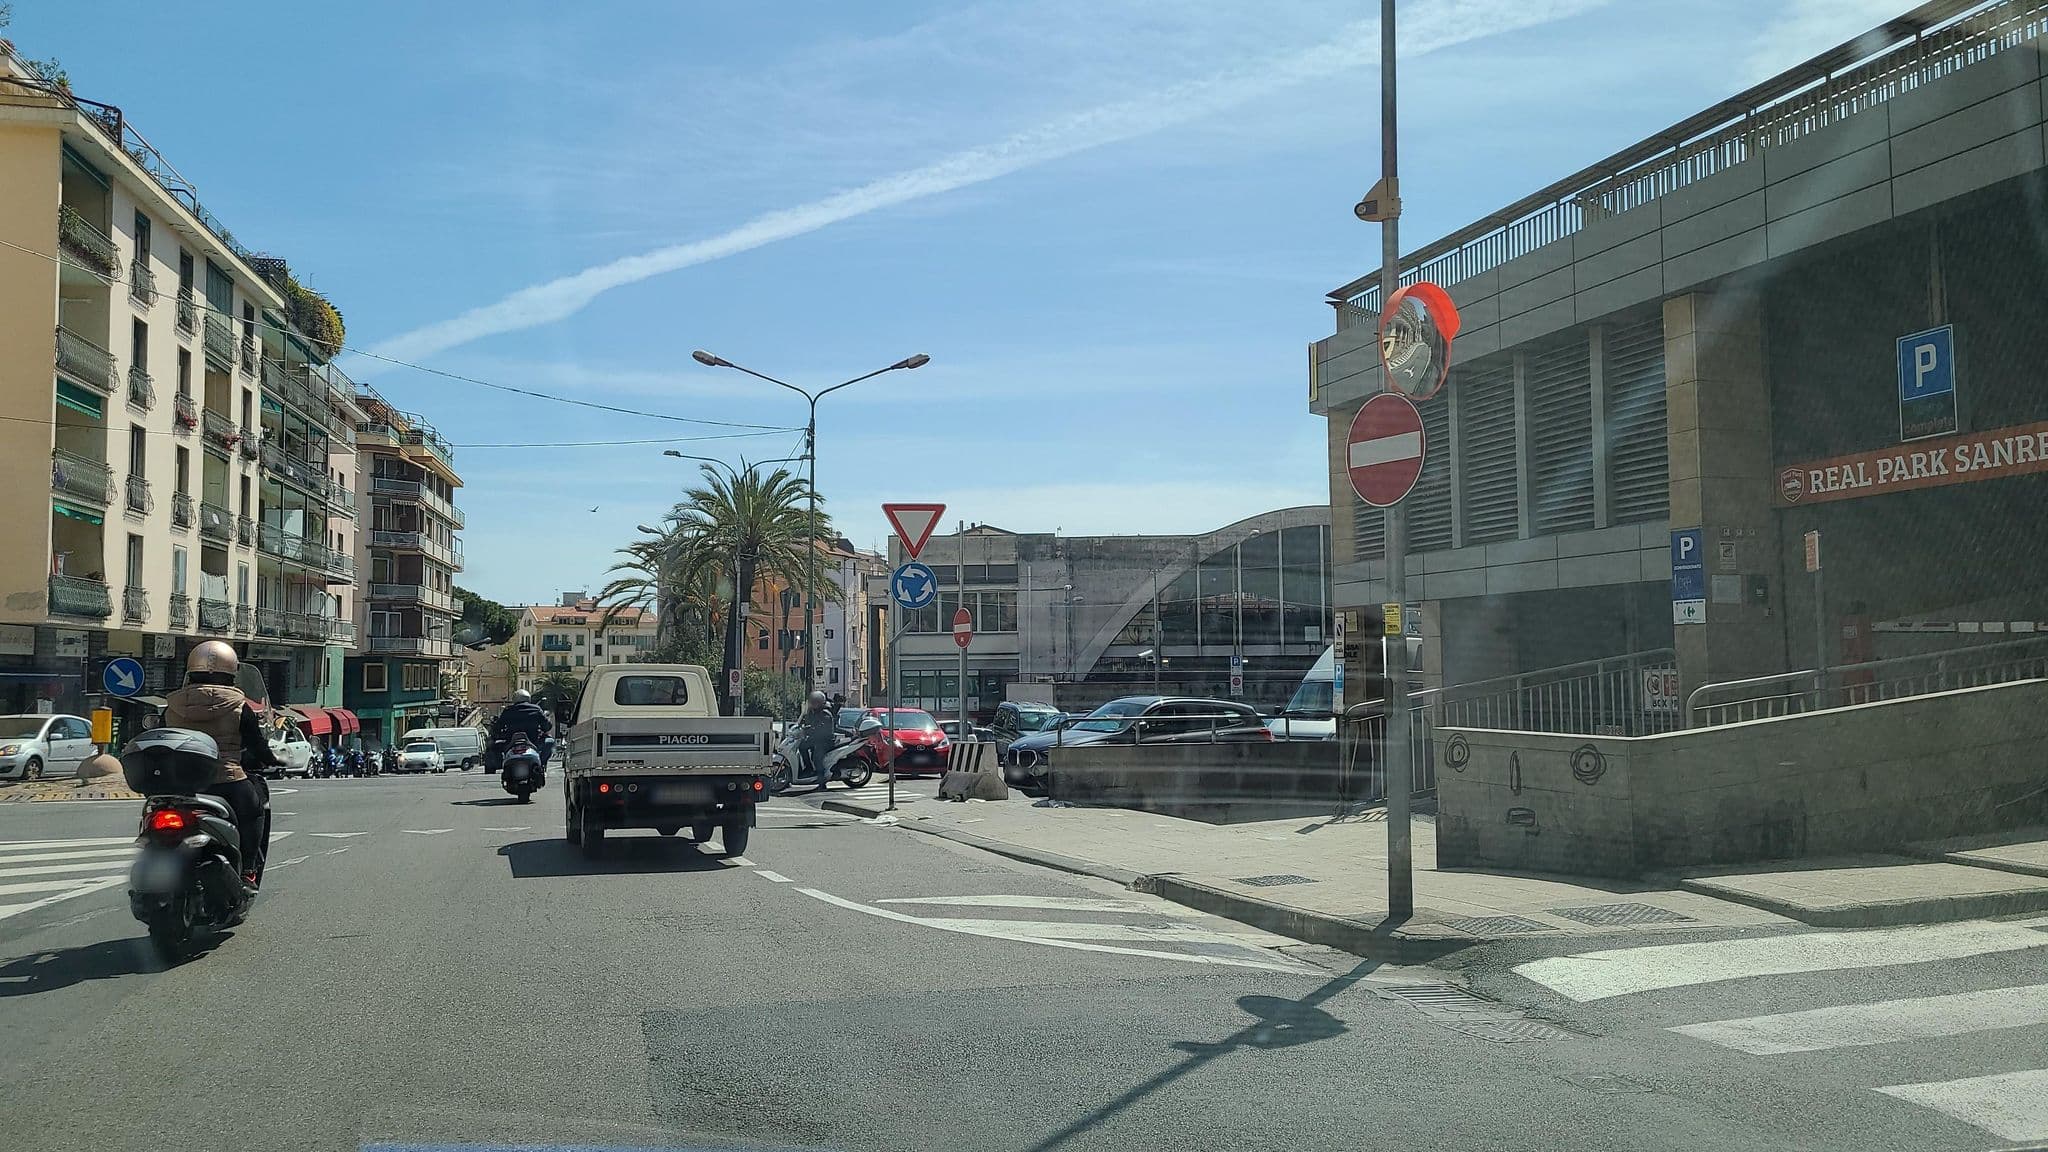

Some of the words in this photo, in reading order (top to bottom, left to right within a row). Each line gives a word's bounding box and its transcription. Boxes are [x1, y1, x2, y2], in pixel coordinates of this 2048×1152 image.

[1914, 343, 1937, 388] P
[1809, 462, 1873, 494] REAL
[1877, 448, 1949, 485] PARK
[1680, 536, 1694, 560] P
[659, 735, 709, 745] PIAGGIO
